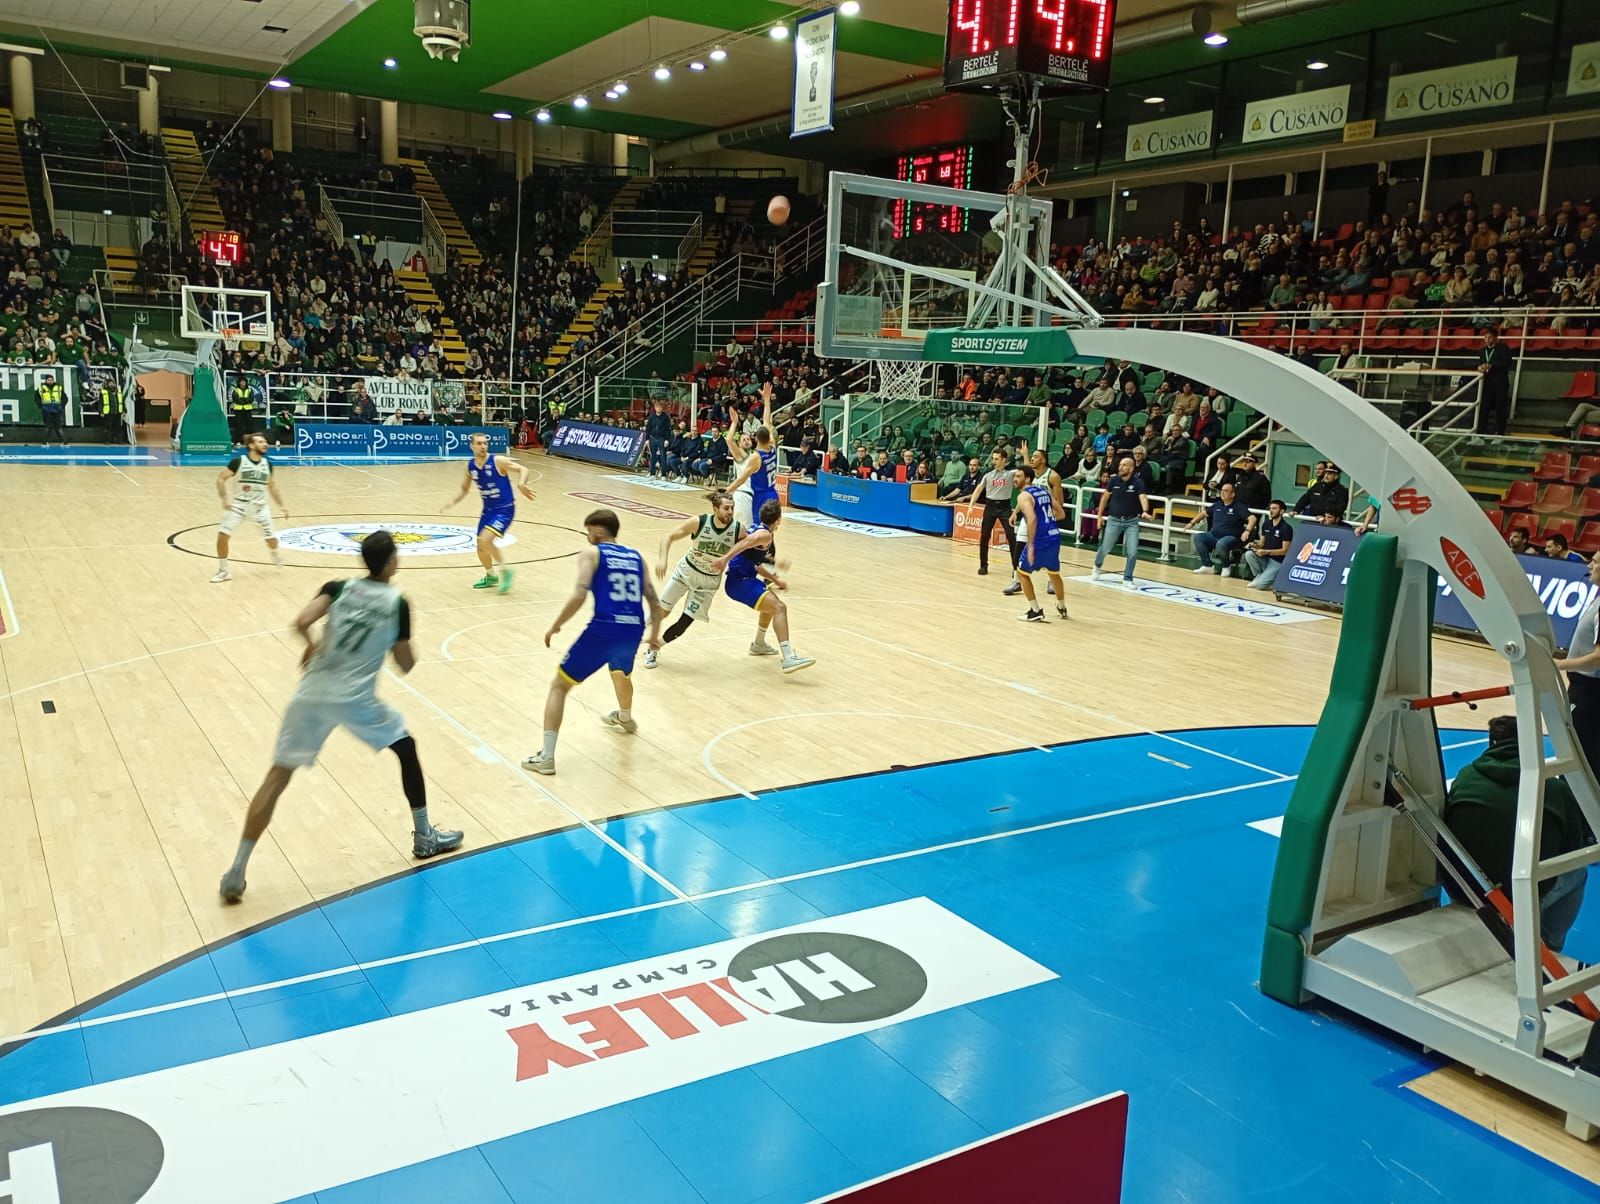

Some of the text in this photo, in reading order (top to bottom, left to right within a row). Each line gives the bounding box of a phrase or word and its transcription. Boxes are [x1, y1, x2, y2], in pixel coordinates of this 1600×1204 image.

[373, 396, 429, 410] LUB ROMA
[315, 432, 350, 440] BONO
[389, 432, 423, 441] BONO
[1448, 550, 1480, 587] ACE
[608, 572, 641, 602] 33
[687, 600, 700, 614] 32
[488, 958, 718, 1017] CAMPANIA
[505, 951, 877, 1082] HALLEY
